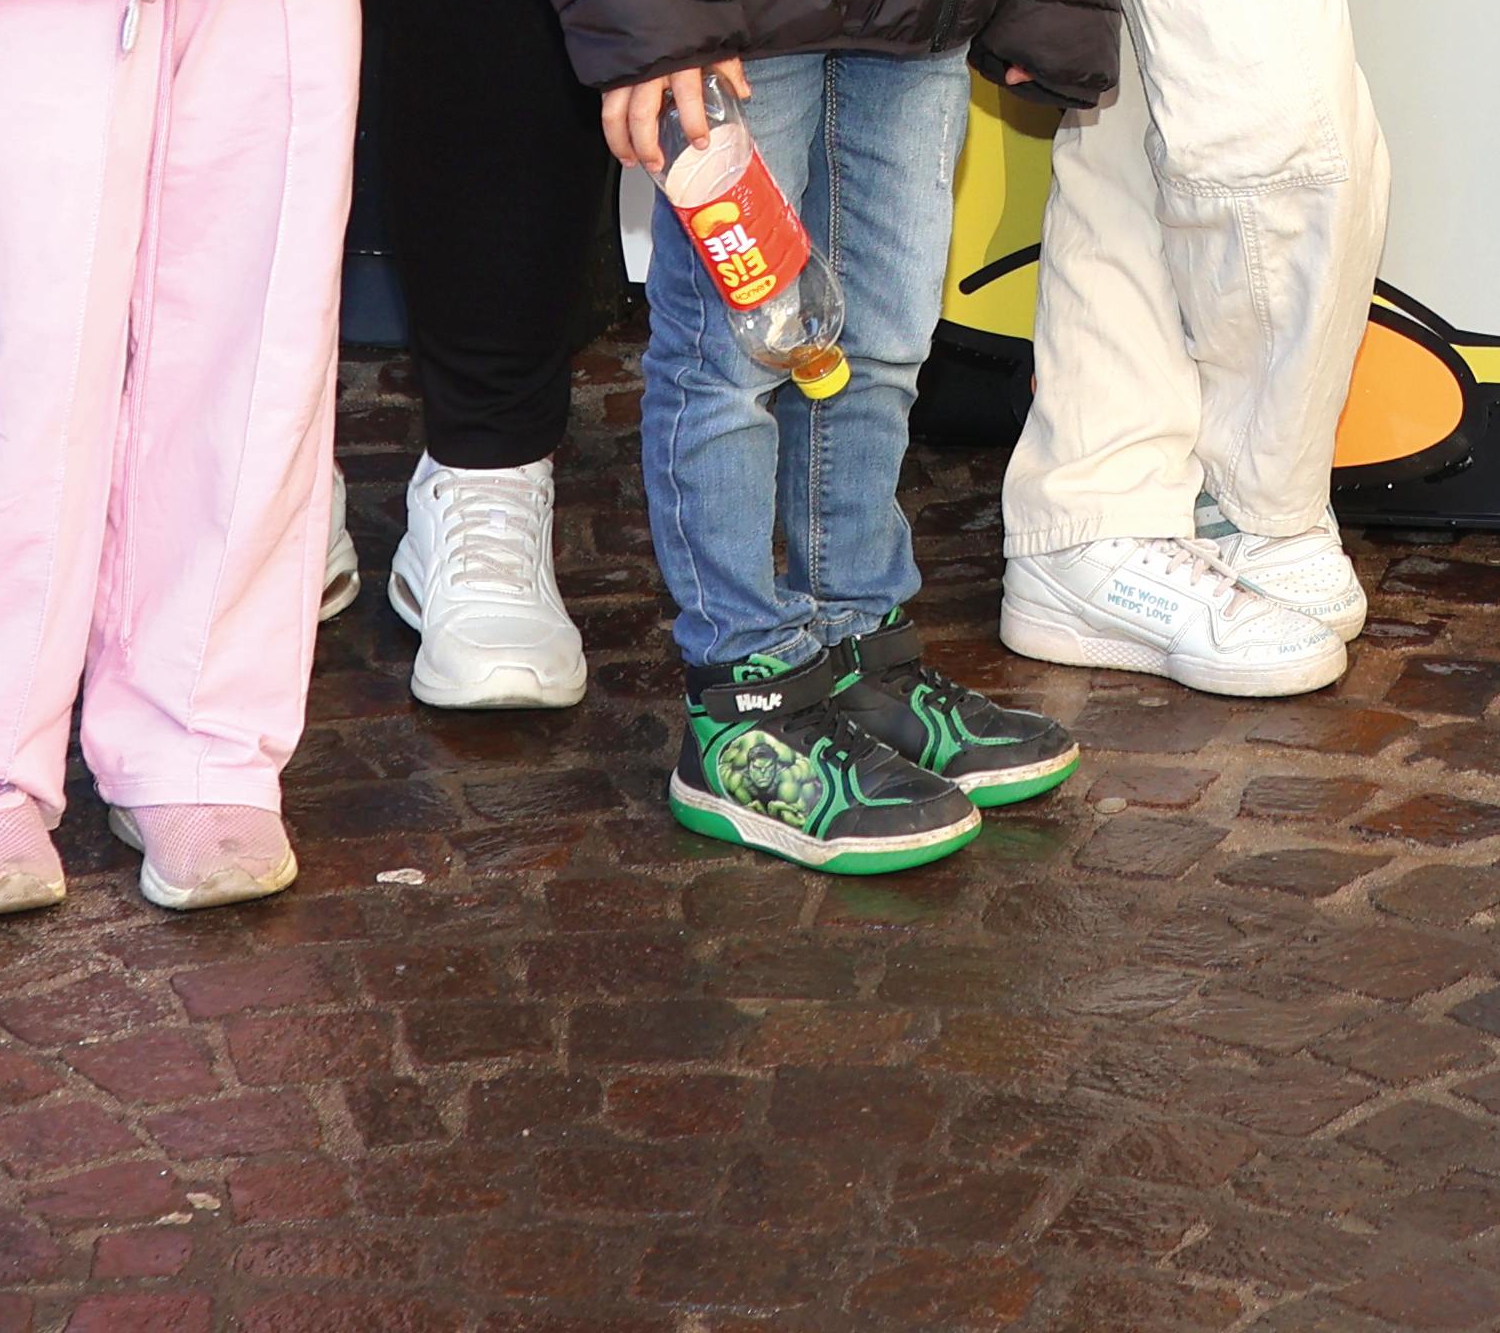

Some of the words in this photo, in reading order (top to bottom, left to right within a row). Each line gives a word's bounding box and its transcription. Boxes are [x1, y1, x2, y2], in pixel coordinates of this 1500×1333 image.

[703, 223, 757, 262] TEE
[1107, 593, 1143, 614] NEEDS
[1146, 607, 1172, 625] LOVE
[1113, 578, 1136, 598] THE
[1138, 589, 1179, 612] WORLD
